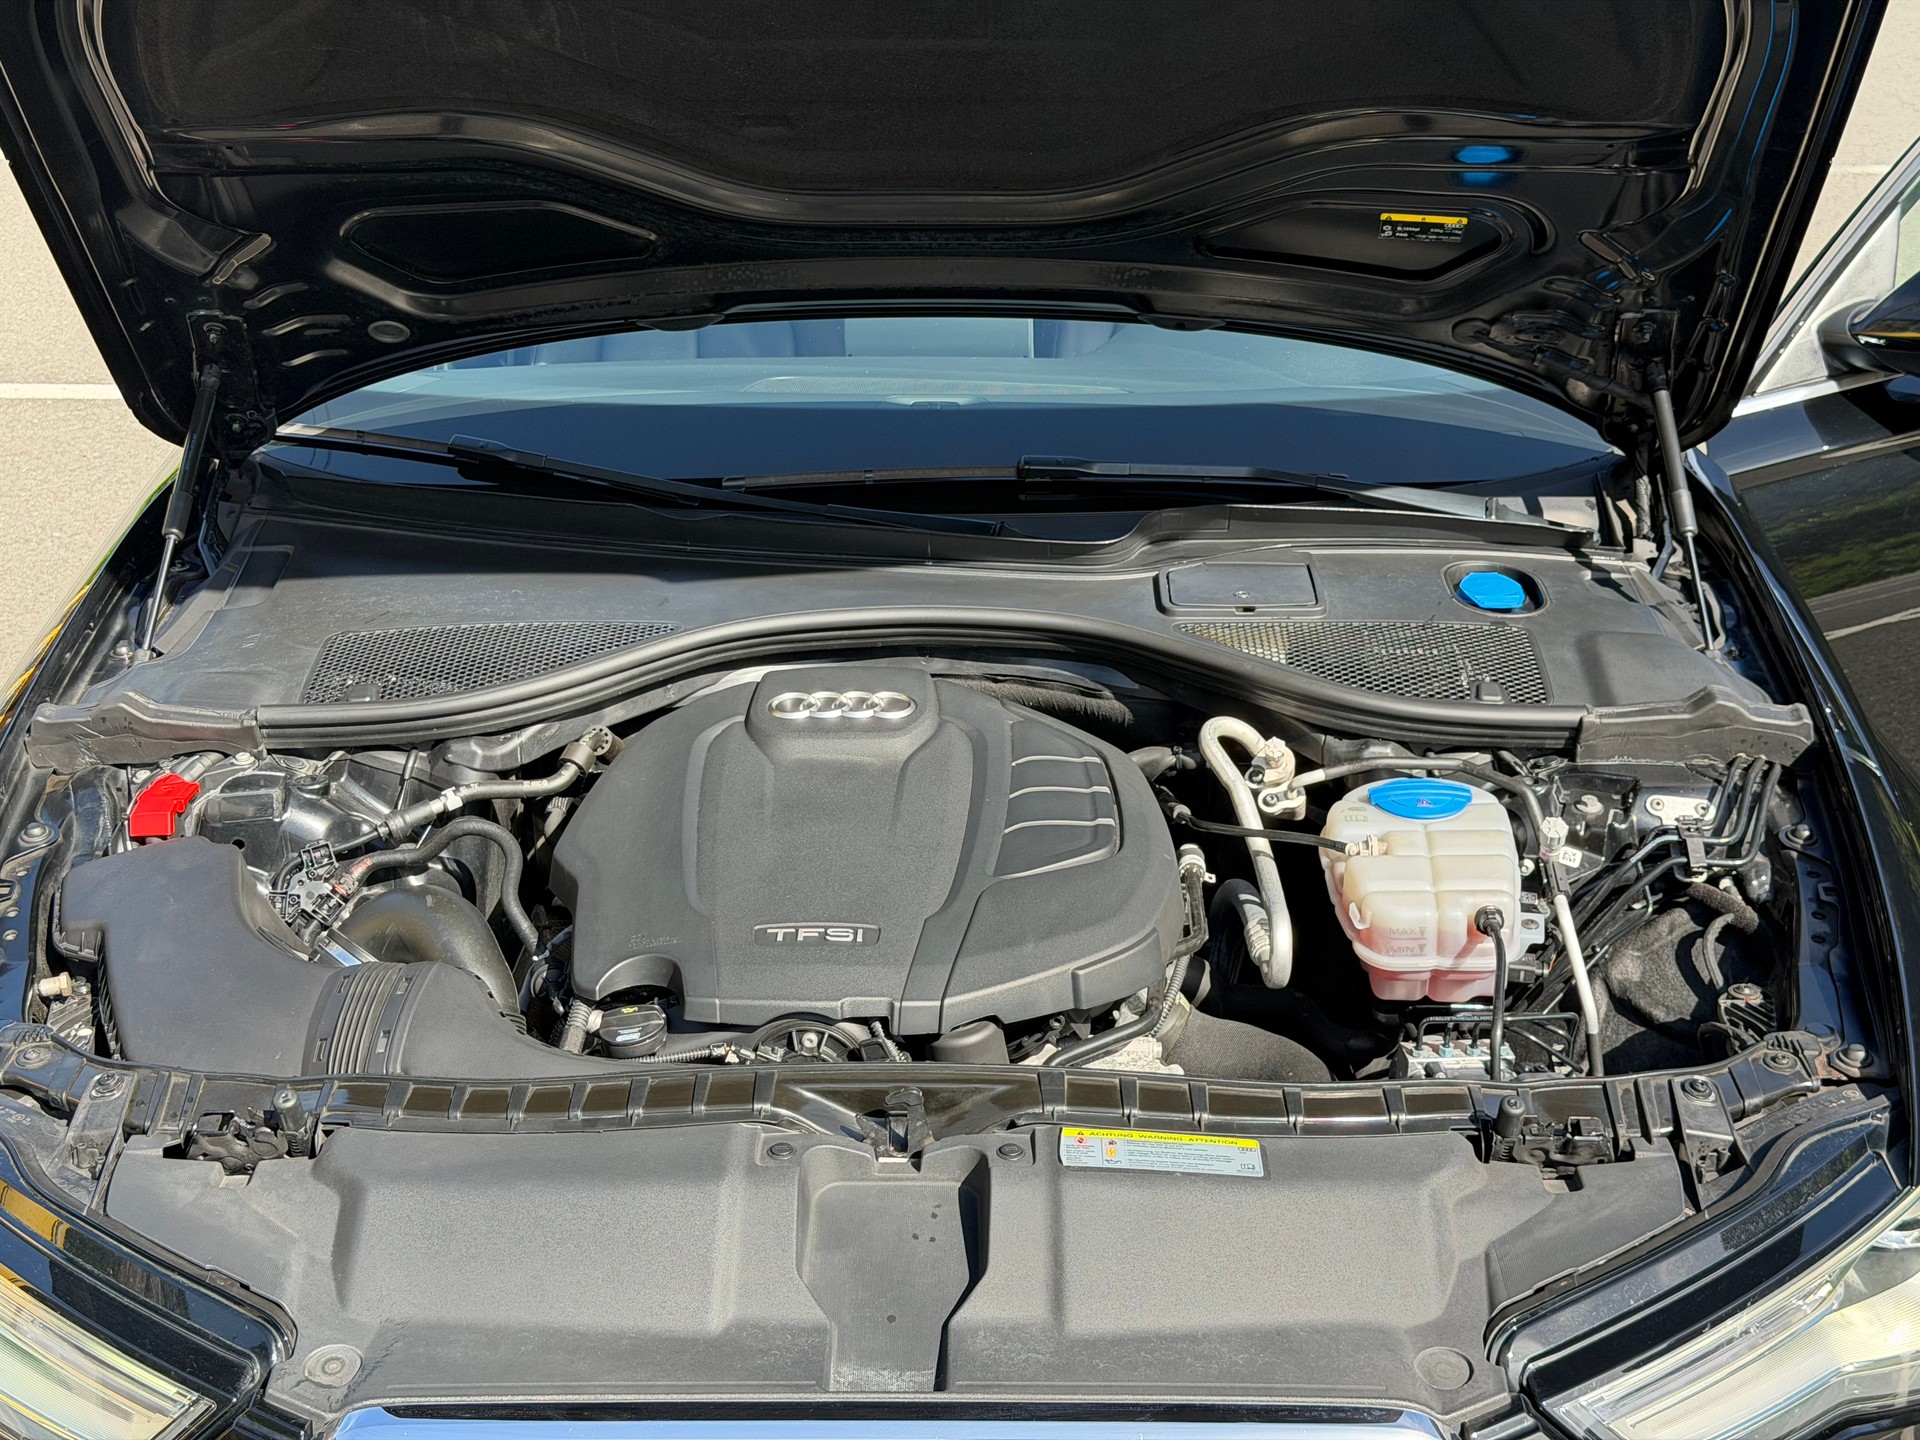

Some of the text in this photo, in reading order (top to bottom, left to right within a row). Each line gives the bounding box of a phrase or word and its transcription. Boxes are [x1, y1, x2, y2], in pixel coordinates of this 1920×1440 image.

[766, 928, 863, 942] TFSI
[1388, 927, 1417, 936] MAX
[1389, 945, 1415, 953] MIN
[1138, 1134, 1183, 1142] WARNING
[1188, 1136, 1238, 1145] ATTENTION
